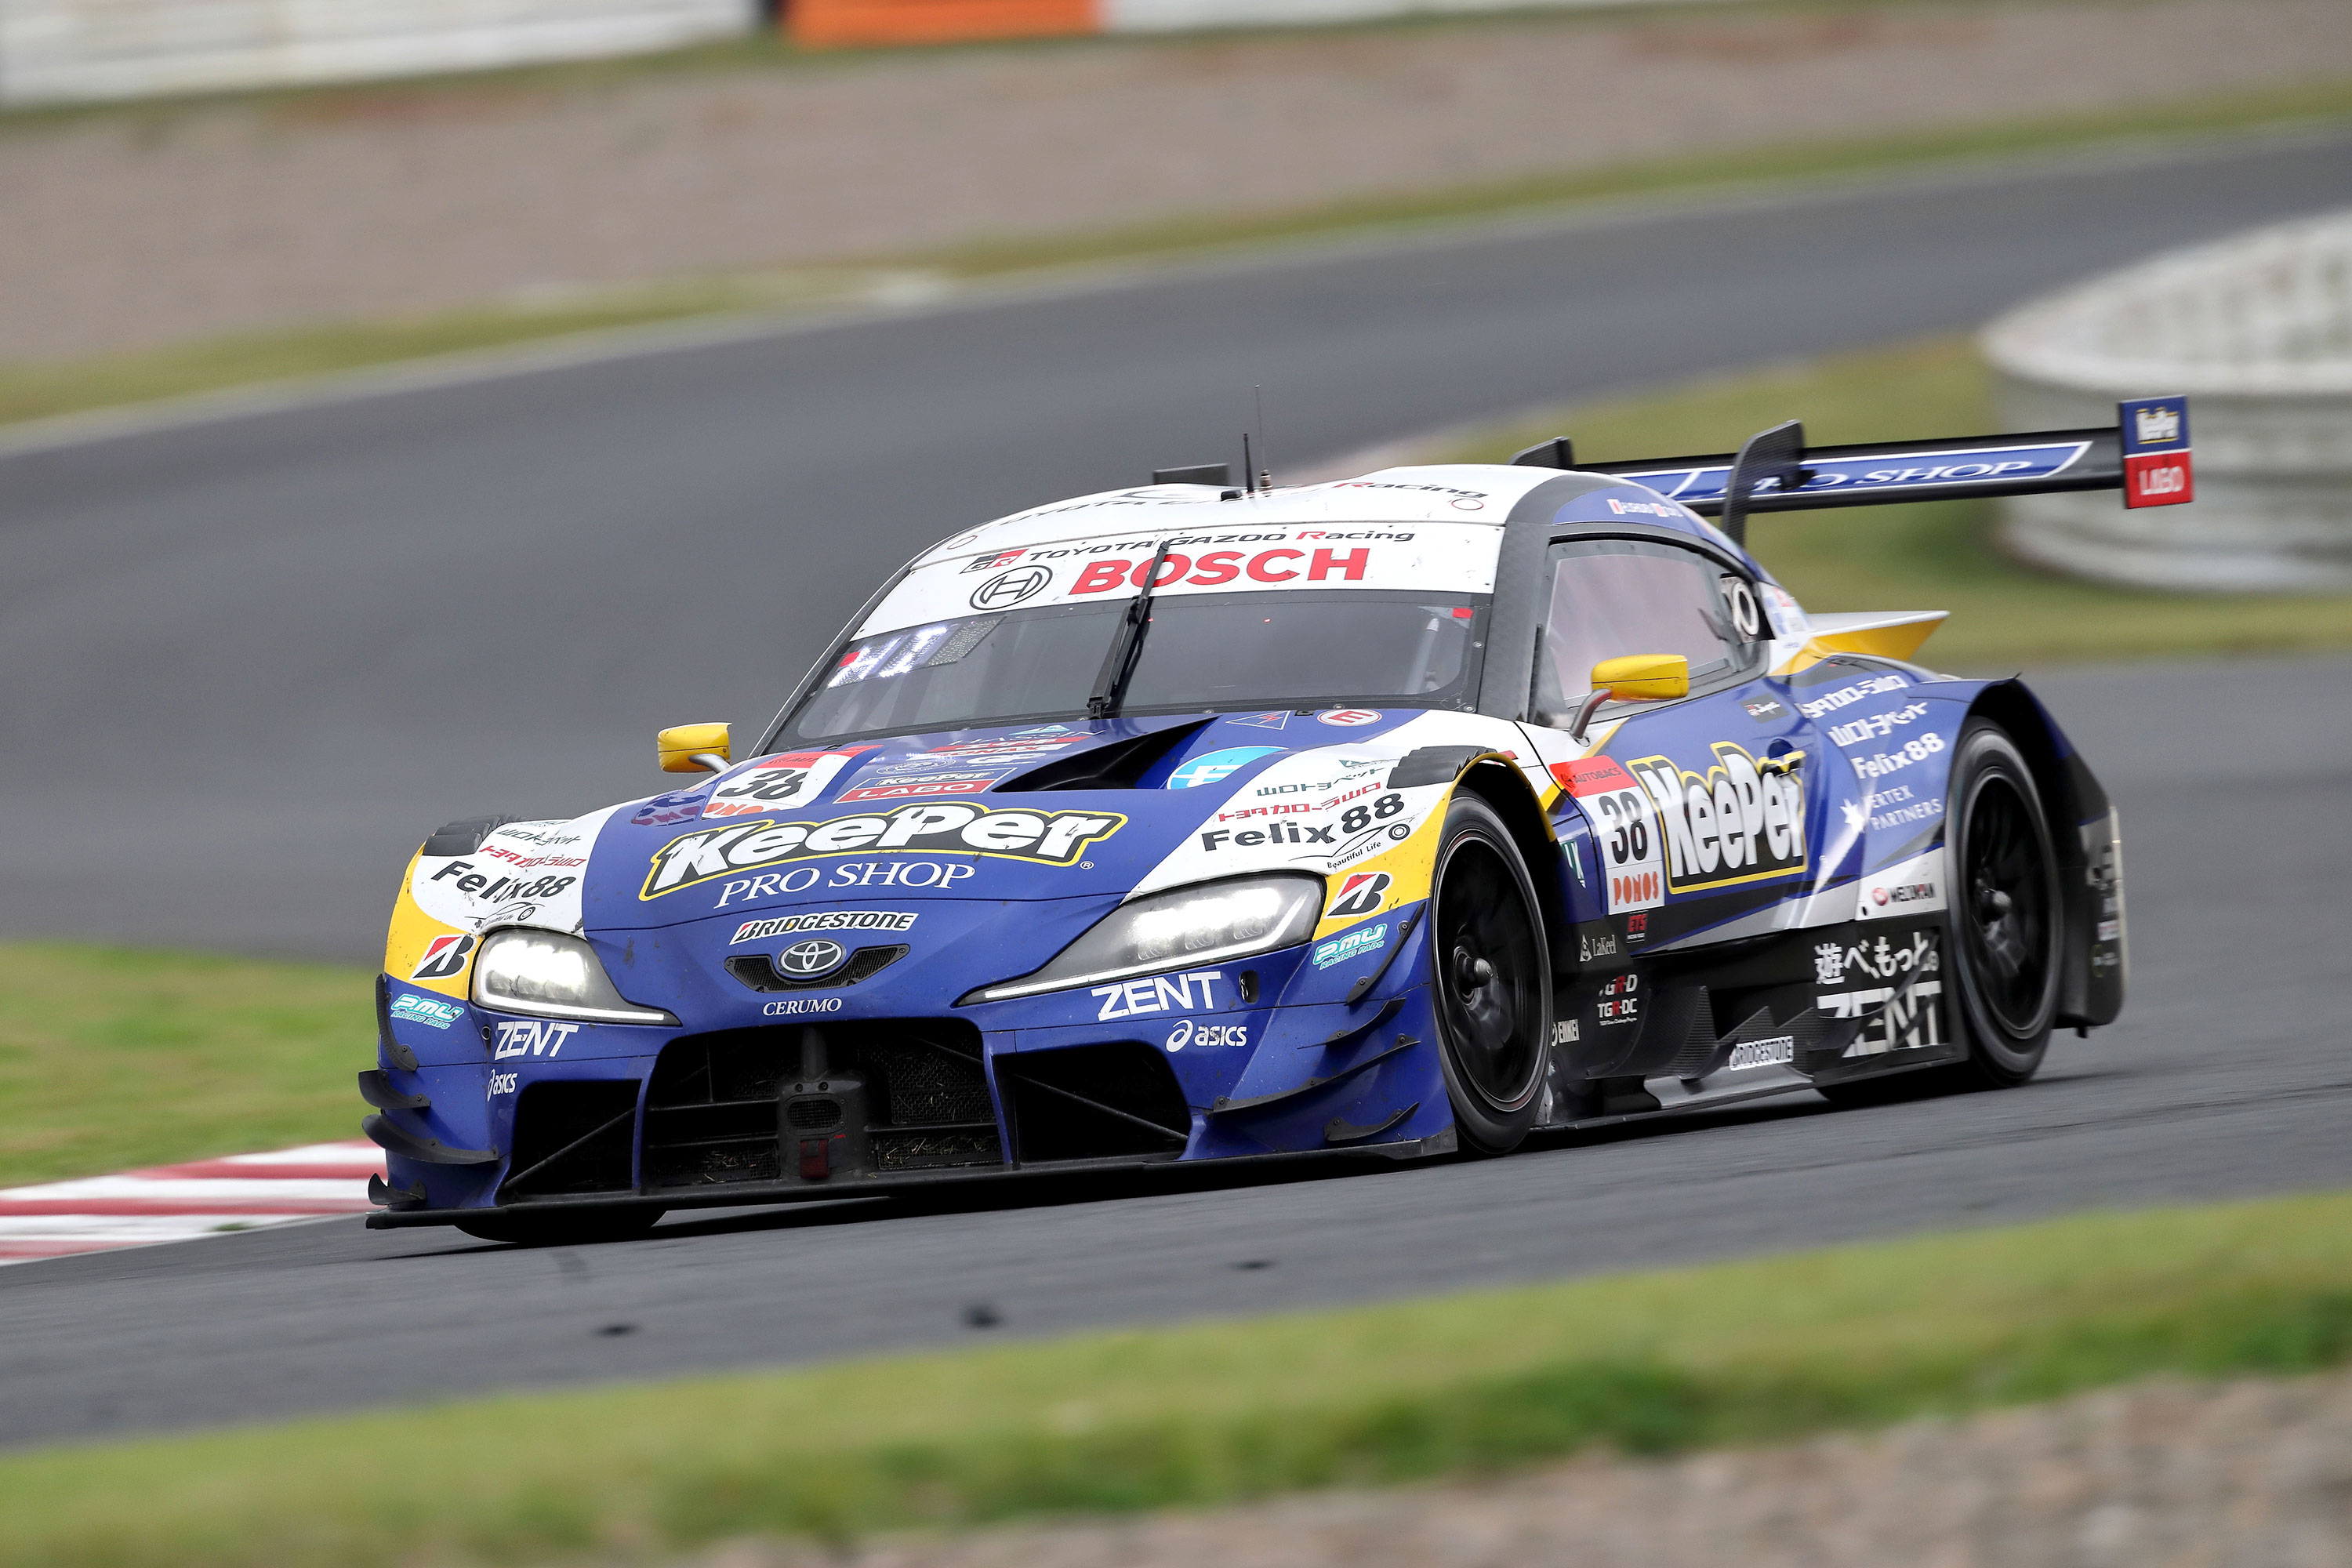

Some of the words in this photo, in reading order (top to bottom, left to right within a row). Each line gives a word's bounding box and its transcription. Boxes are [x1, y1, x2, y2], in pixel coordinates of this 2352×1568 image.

[1854, 460, 2033, 485] SHOP
[1335, 481, 1489, 499] Racing
[1029, 539, 1154, 561] TOYOTA
[1167, 532, 1287, 547] GAZOO
[1296, 530, 1415, 543] Racing
[1068, 547, 1371, 596] BOSCH
[716, 768, 809, 800] 38
[857, 783, 975, 798] LABO
[1573, 766, 1623, 784] AUTOBACS
[1598, 791, 1648, 865] 38
[1634, 749, 1805, 886] KeePer
[1869, 797, 1944, 831] PARTNERS
[646, 802, 1122, 895] KeePer
[1327, 848, 1363, 869] Beautiful
[1367, 840, 1382, 853] Life
[713, 867, 820, 909] PRO
[828, 861, 976, 890] SHOP
[1613, 871, 1659, 906] PONOS
[732, 912, 916, 943] BRIDGESTONE
[1319, 948, 1357, 971] RACING
[1357, 940, 1385, 955] PADS
[1091, 971, 1222, 1022] ZENT
[1598, 974, 1639, 997] GR-D
[390, 1010, 425, 1025] RACING
[425, 1019, 452, 1031] PADS
[762, 997, 843, 1016] CERUMO
[495, 1021, 580, 1061] ZENT
[1193, 1025, 1248, 1048] asics
[493, 1072, 518, 1095] asics
